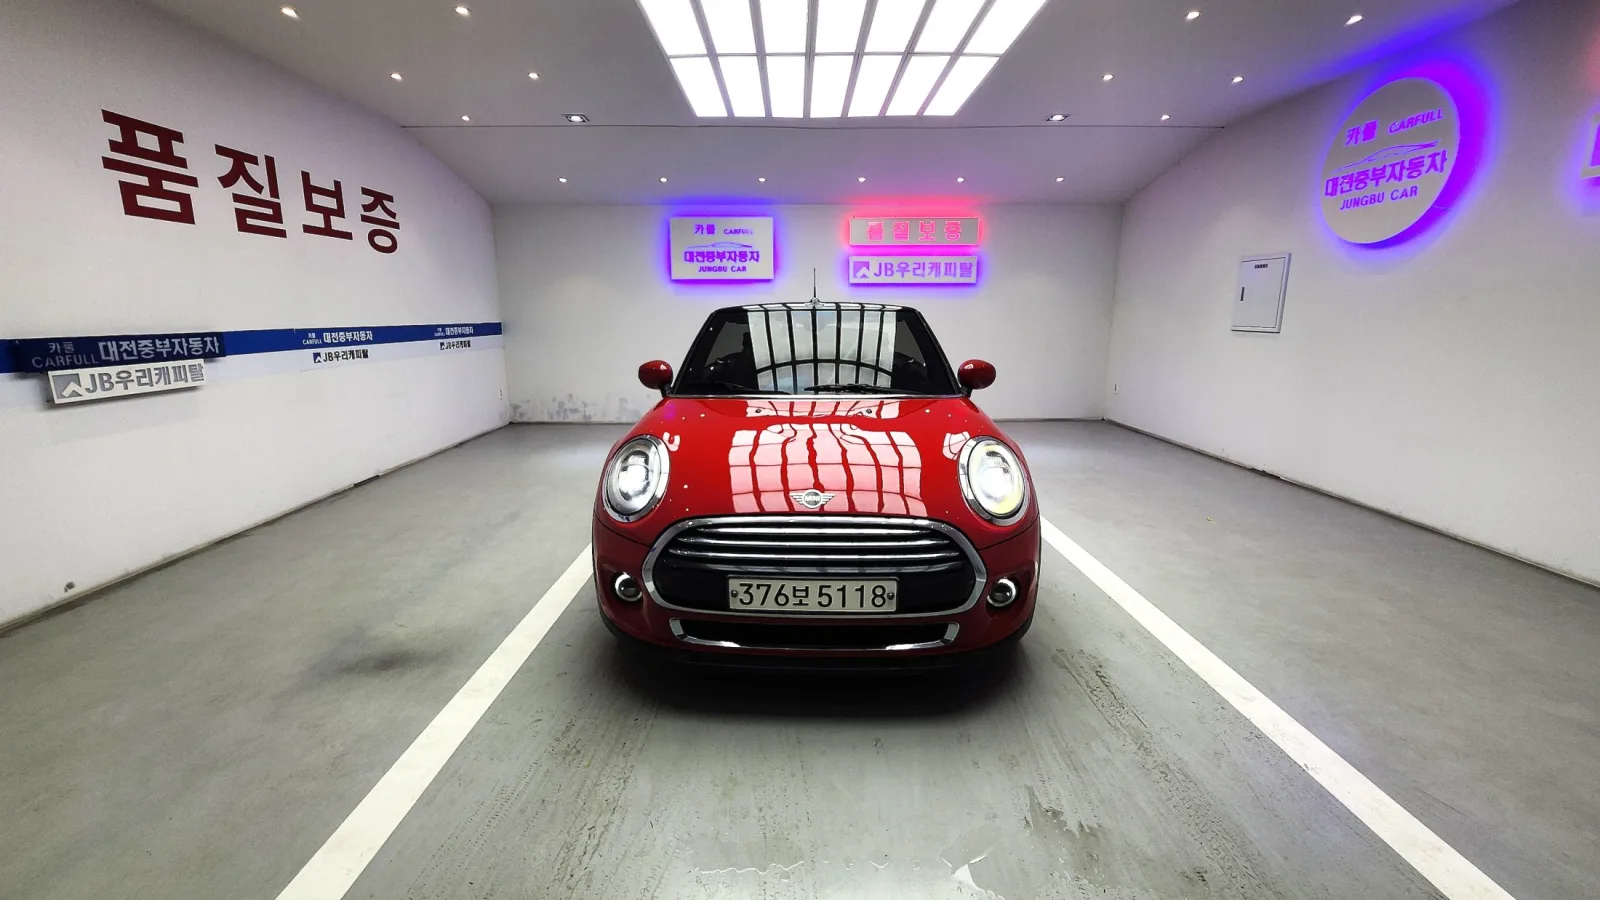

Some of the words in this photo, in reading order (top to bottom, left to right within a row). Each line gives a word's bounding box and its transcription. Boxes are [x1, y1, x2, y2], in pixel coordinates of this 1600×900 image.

[1389, 108, 1444, 134] CARFULL
[101, 109, 400, 253] 품질보증
[1340, 192, 1385, 210] JUNGBU
[1390, 185, 1418, 201] CAR
[873, 261, 974, 278] JB우리캐피탈
[32, 354, 99, 369] CARFULL
[98, 336, 220, 362] 대전중부자동차
[85, 363, 205, 394] JB우리캐피탈
[739, 582, 809, 607] 376보
[817, 584, 887, 608] 5118
